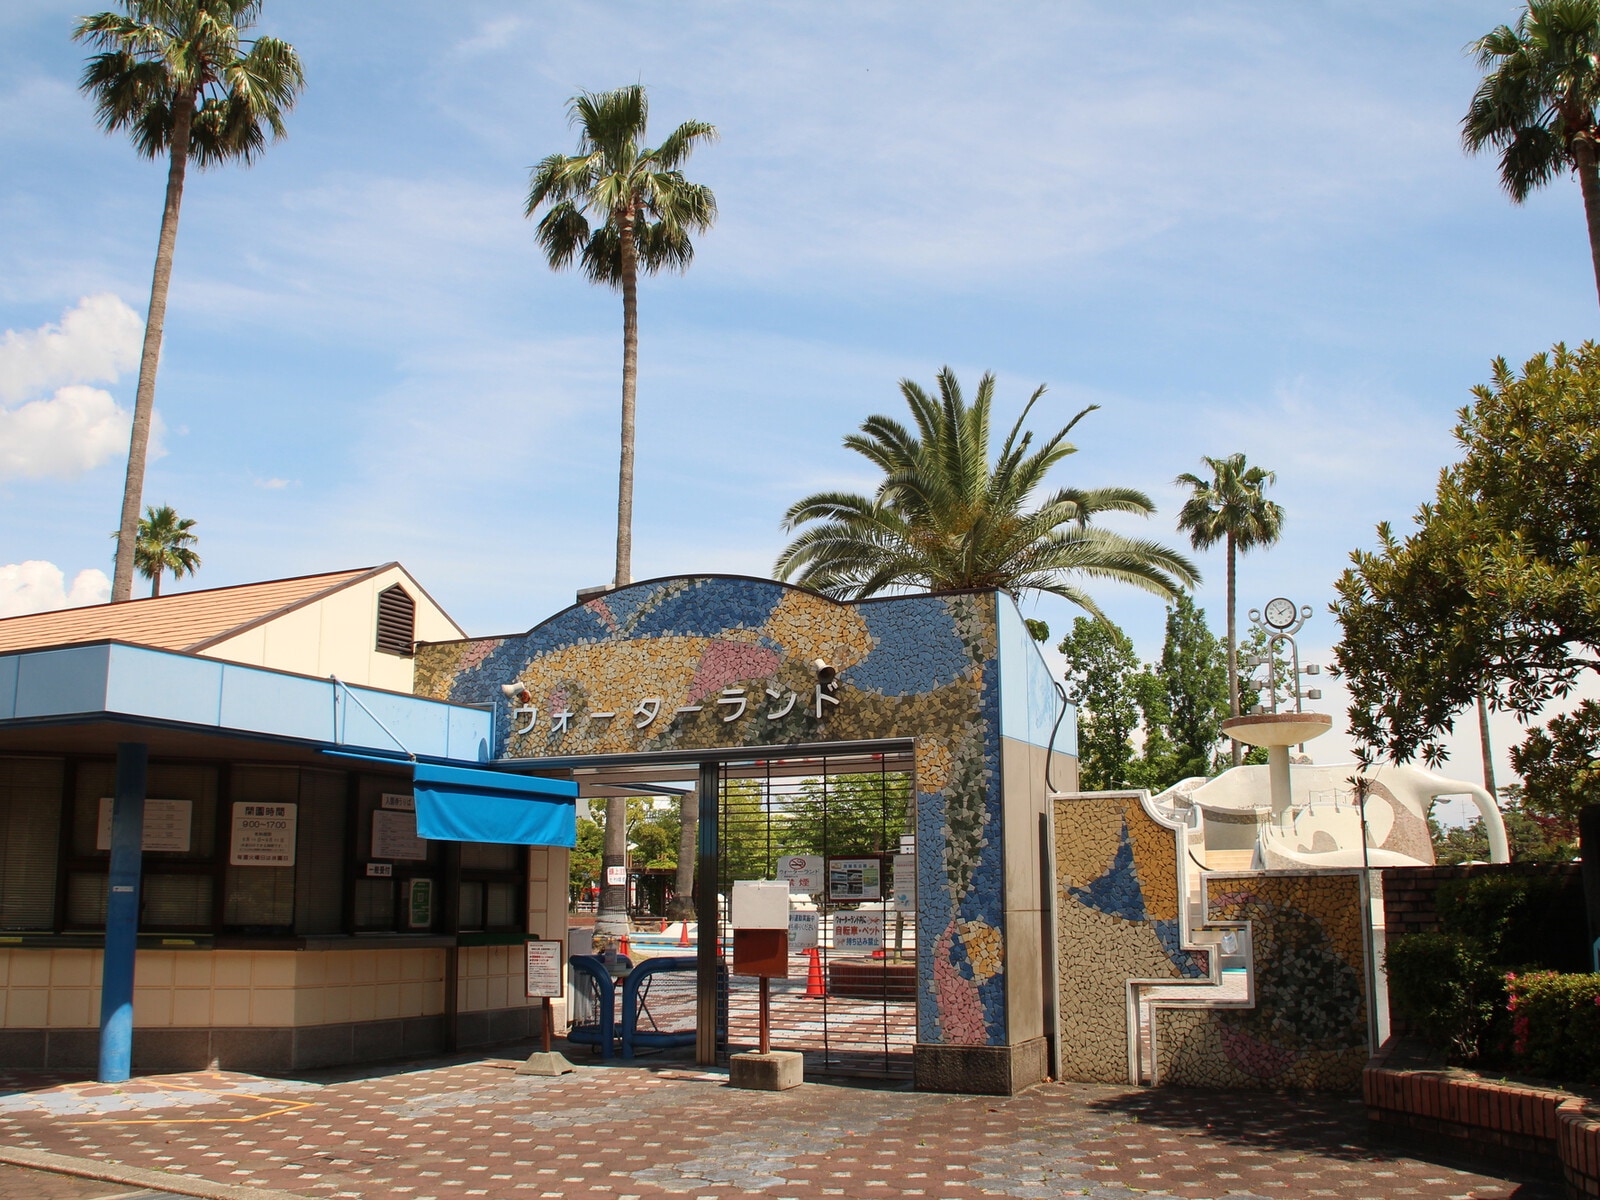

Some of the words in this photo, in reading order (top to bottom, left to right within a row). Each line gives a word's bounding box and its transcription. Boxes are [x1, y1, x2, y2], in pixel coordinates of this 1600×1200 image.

[513, 681, 840, 736] ウォーターランド
[245, 806, 285, 817] 開園時間
[835, 925, 880, 936] 自転車・ペット
[846, 937, 880, 946] 持ち込み禁止
